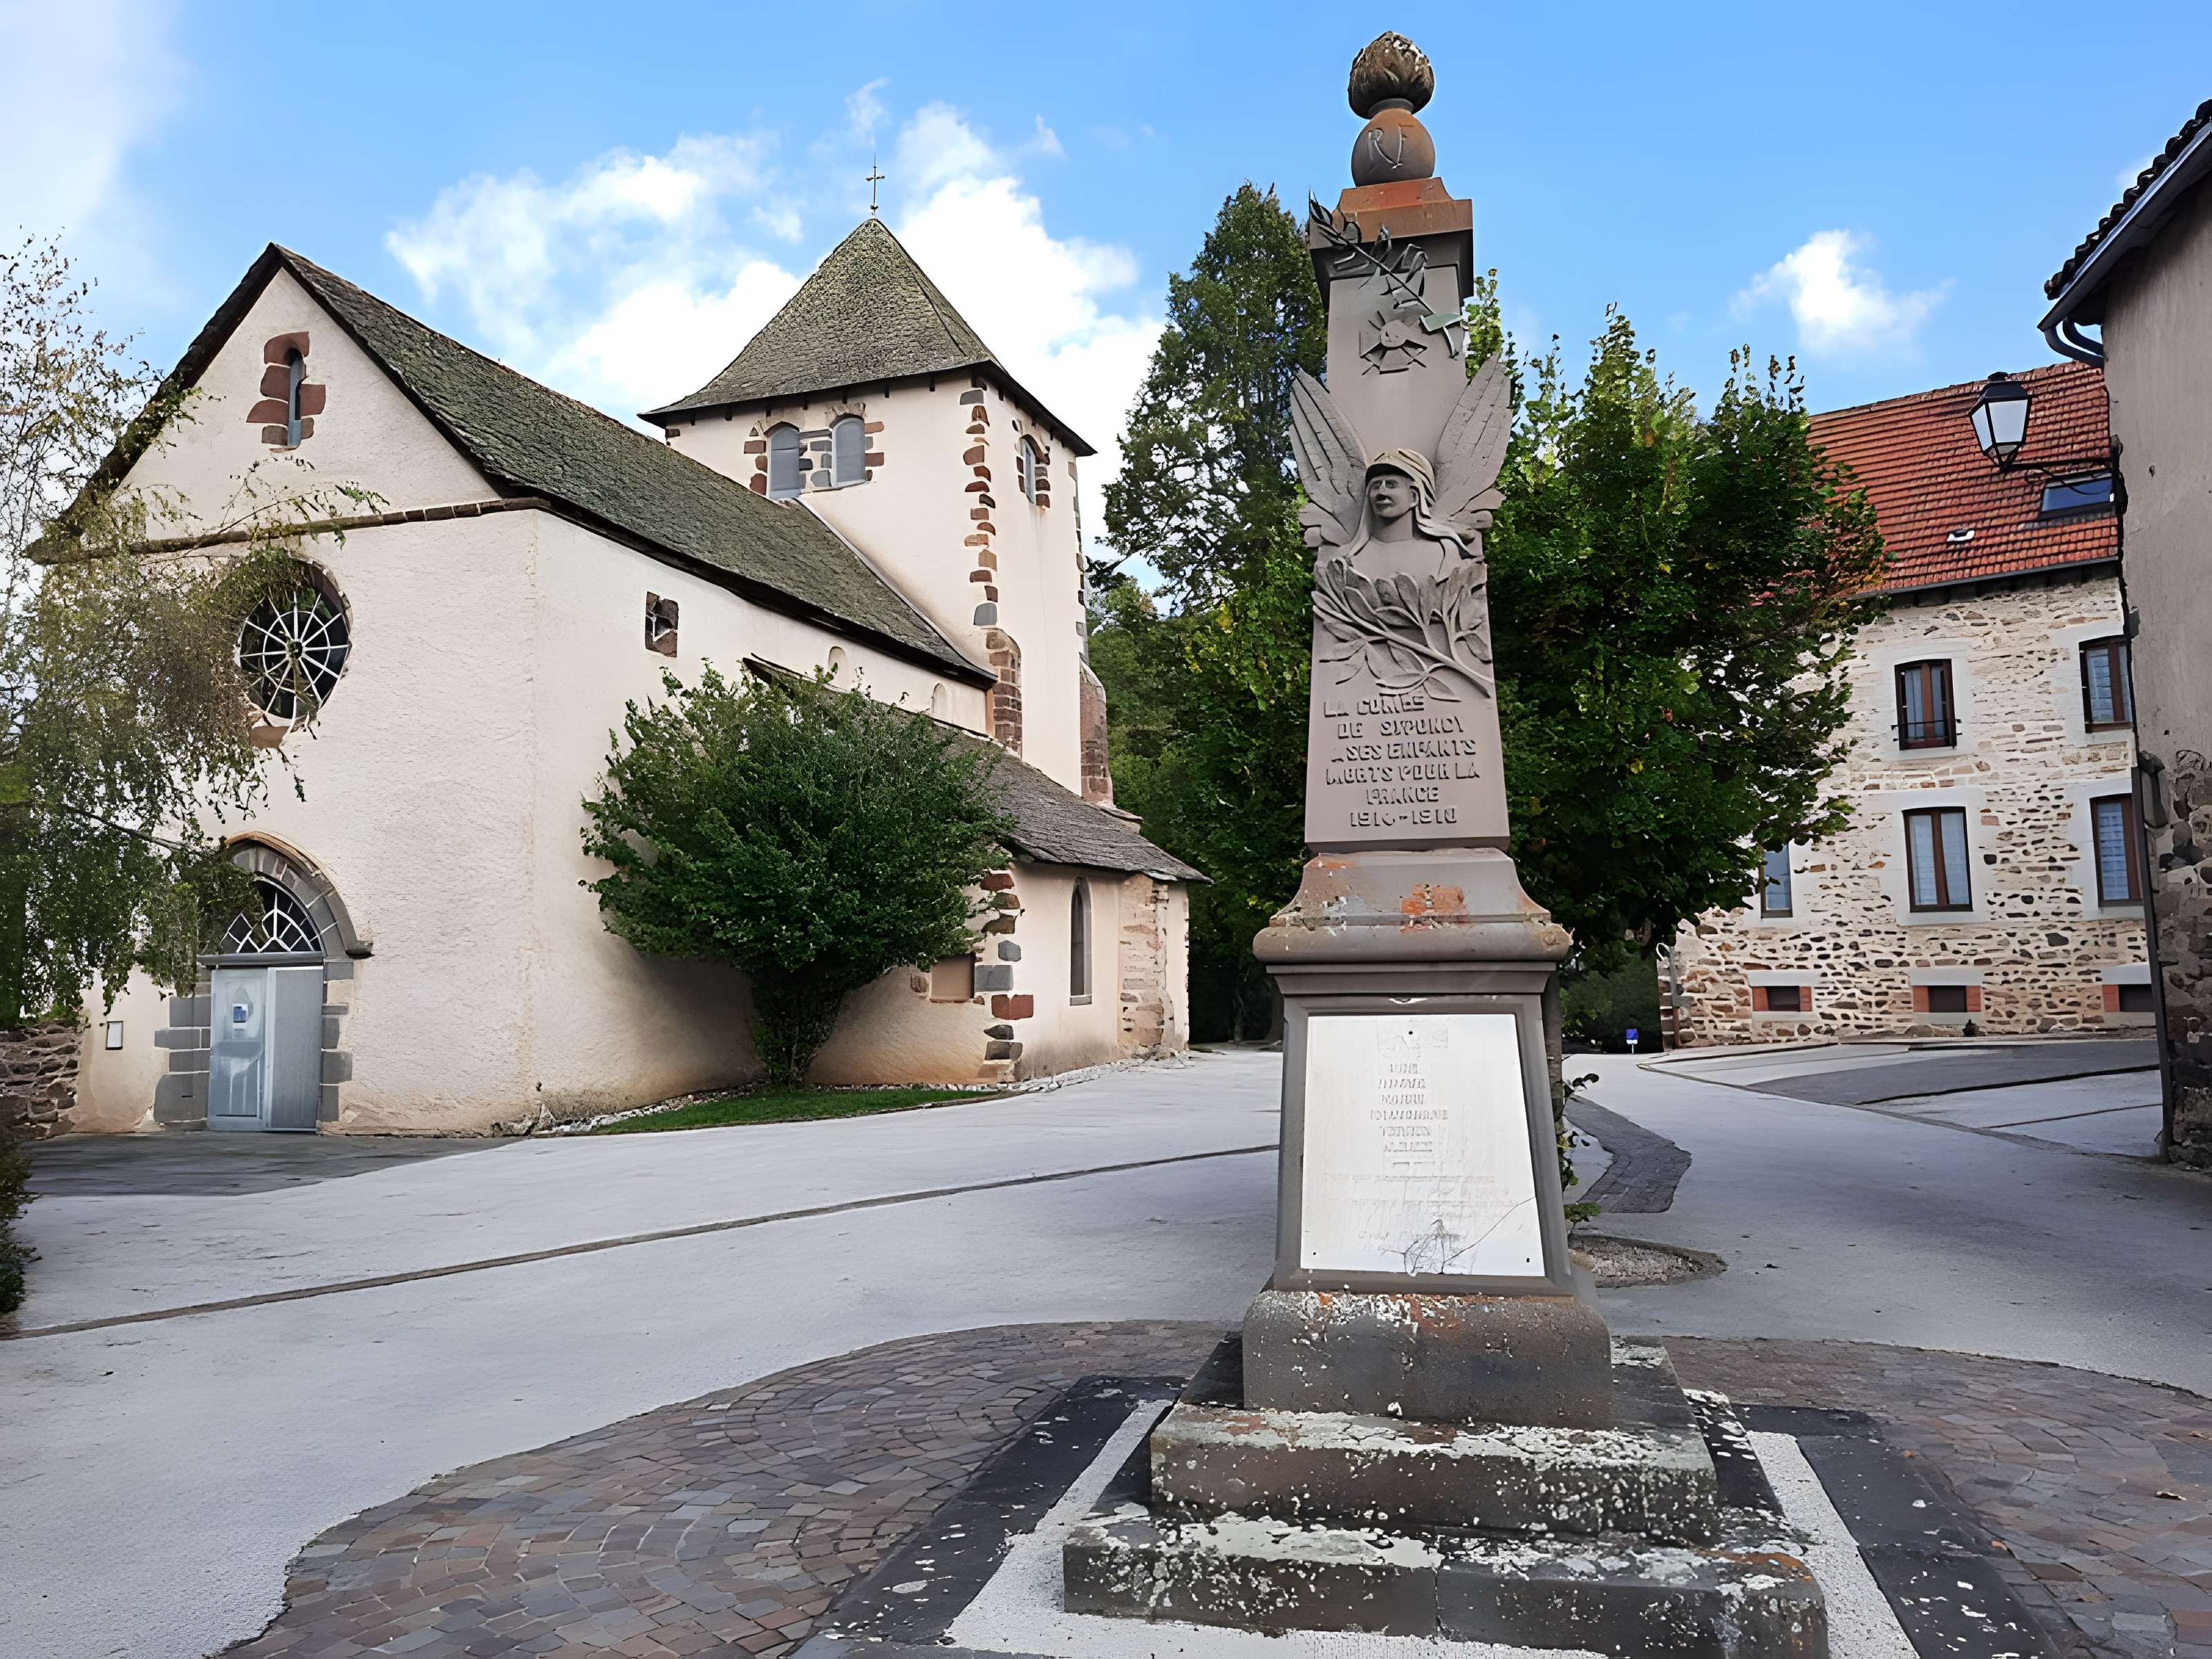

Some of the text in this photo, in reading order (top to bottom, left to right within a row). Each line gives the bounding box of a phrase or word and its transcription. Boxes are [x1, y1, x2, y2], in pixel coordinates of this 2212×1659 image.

[1324, 700, 1350, 718] LA
[1338, 722, 1363, 740] DE
[1398, 764, 1450, 781] POUR
[1454, 762, 1480, 780] LA
